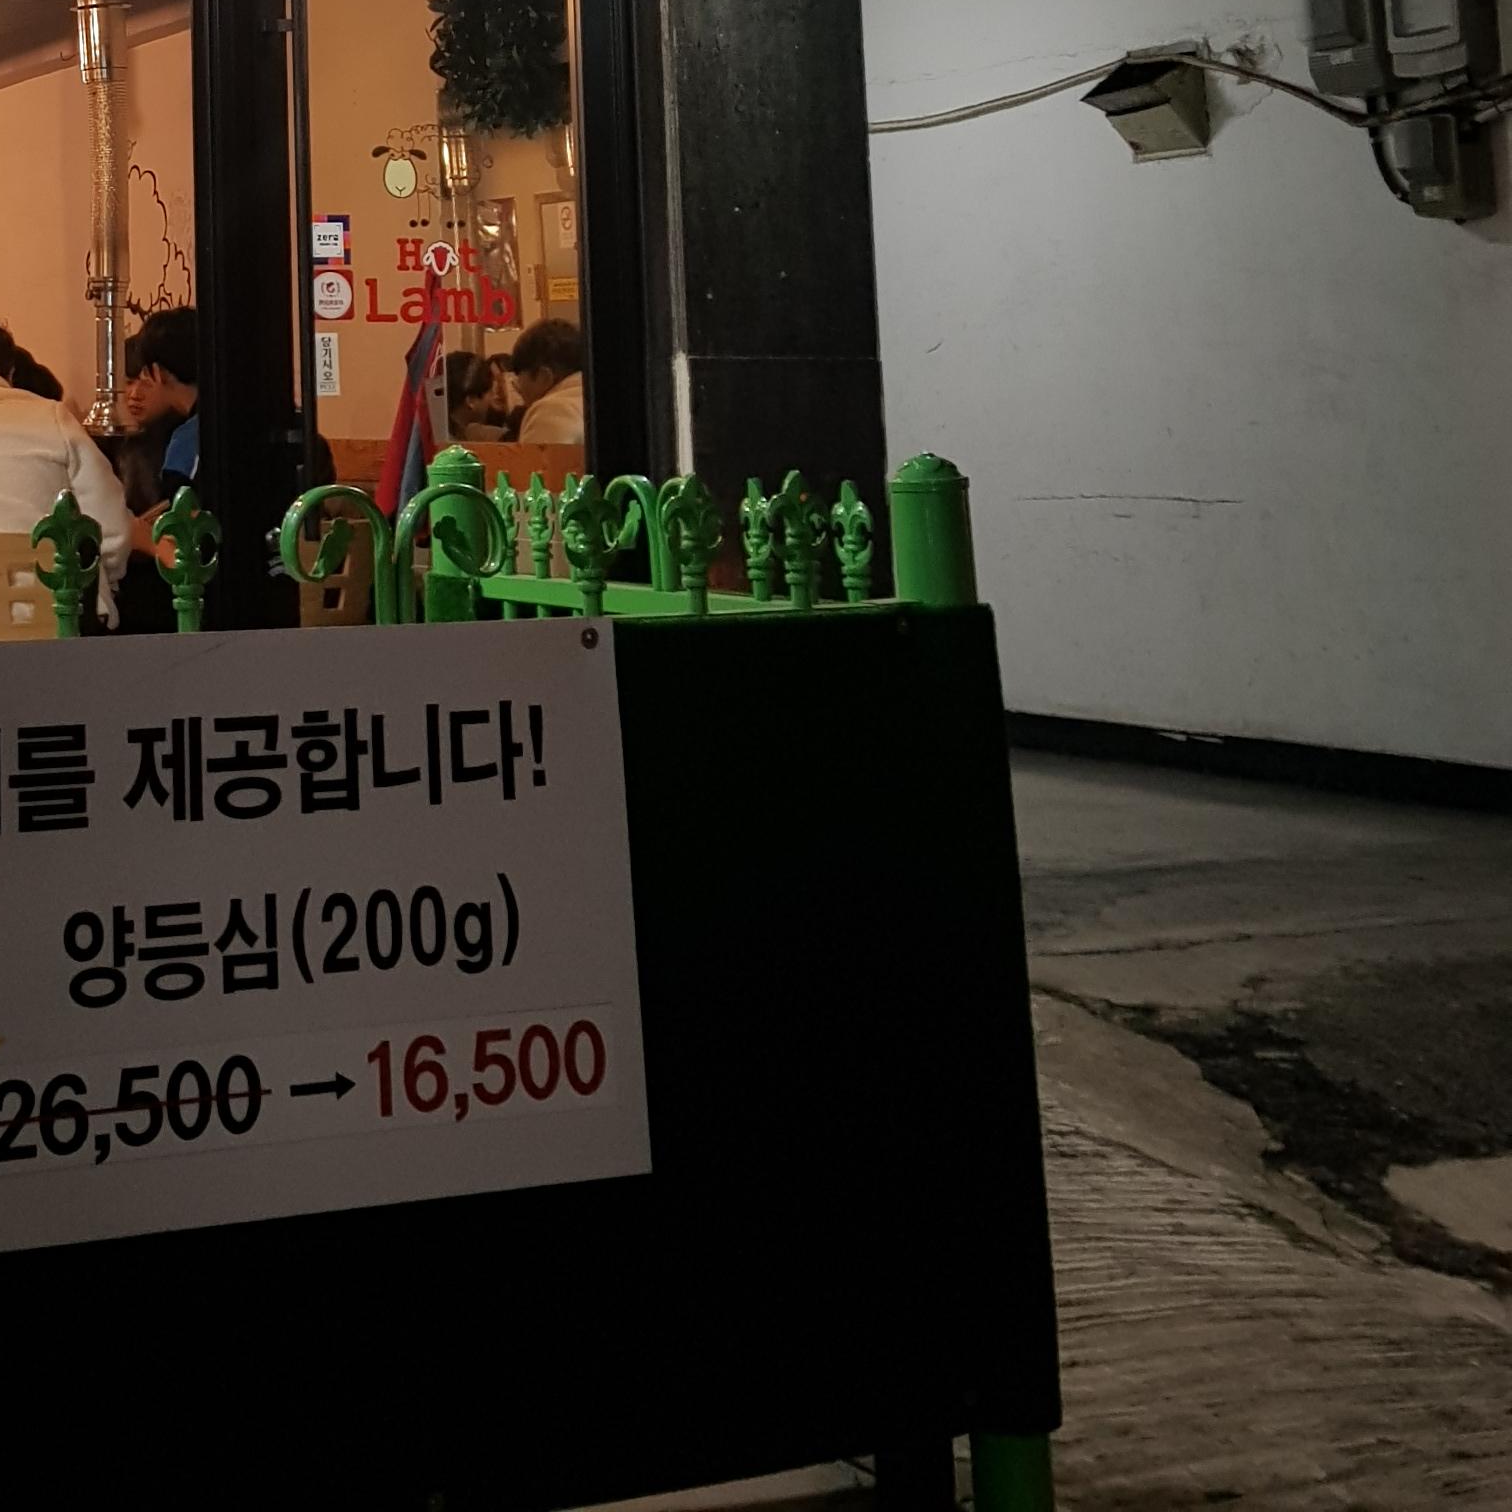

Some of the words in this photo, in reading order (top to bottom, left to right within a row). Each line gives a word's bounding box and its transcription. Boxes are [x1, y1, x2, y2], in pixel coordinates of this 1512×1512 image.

[365, 275, 517, 324] Lamb
[397, 238, 482, 276] Hot
[123, 700, 547, 822] 제공합니다!
[63, 872, 520, 1009] 양등심(200g)
[367, 1019, 606, 1122] 16,500
